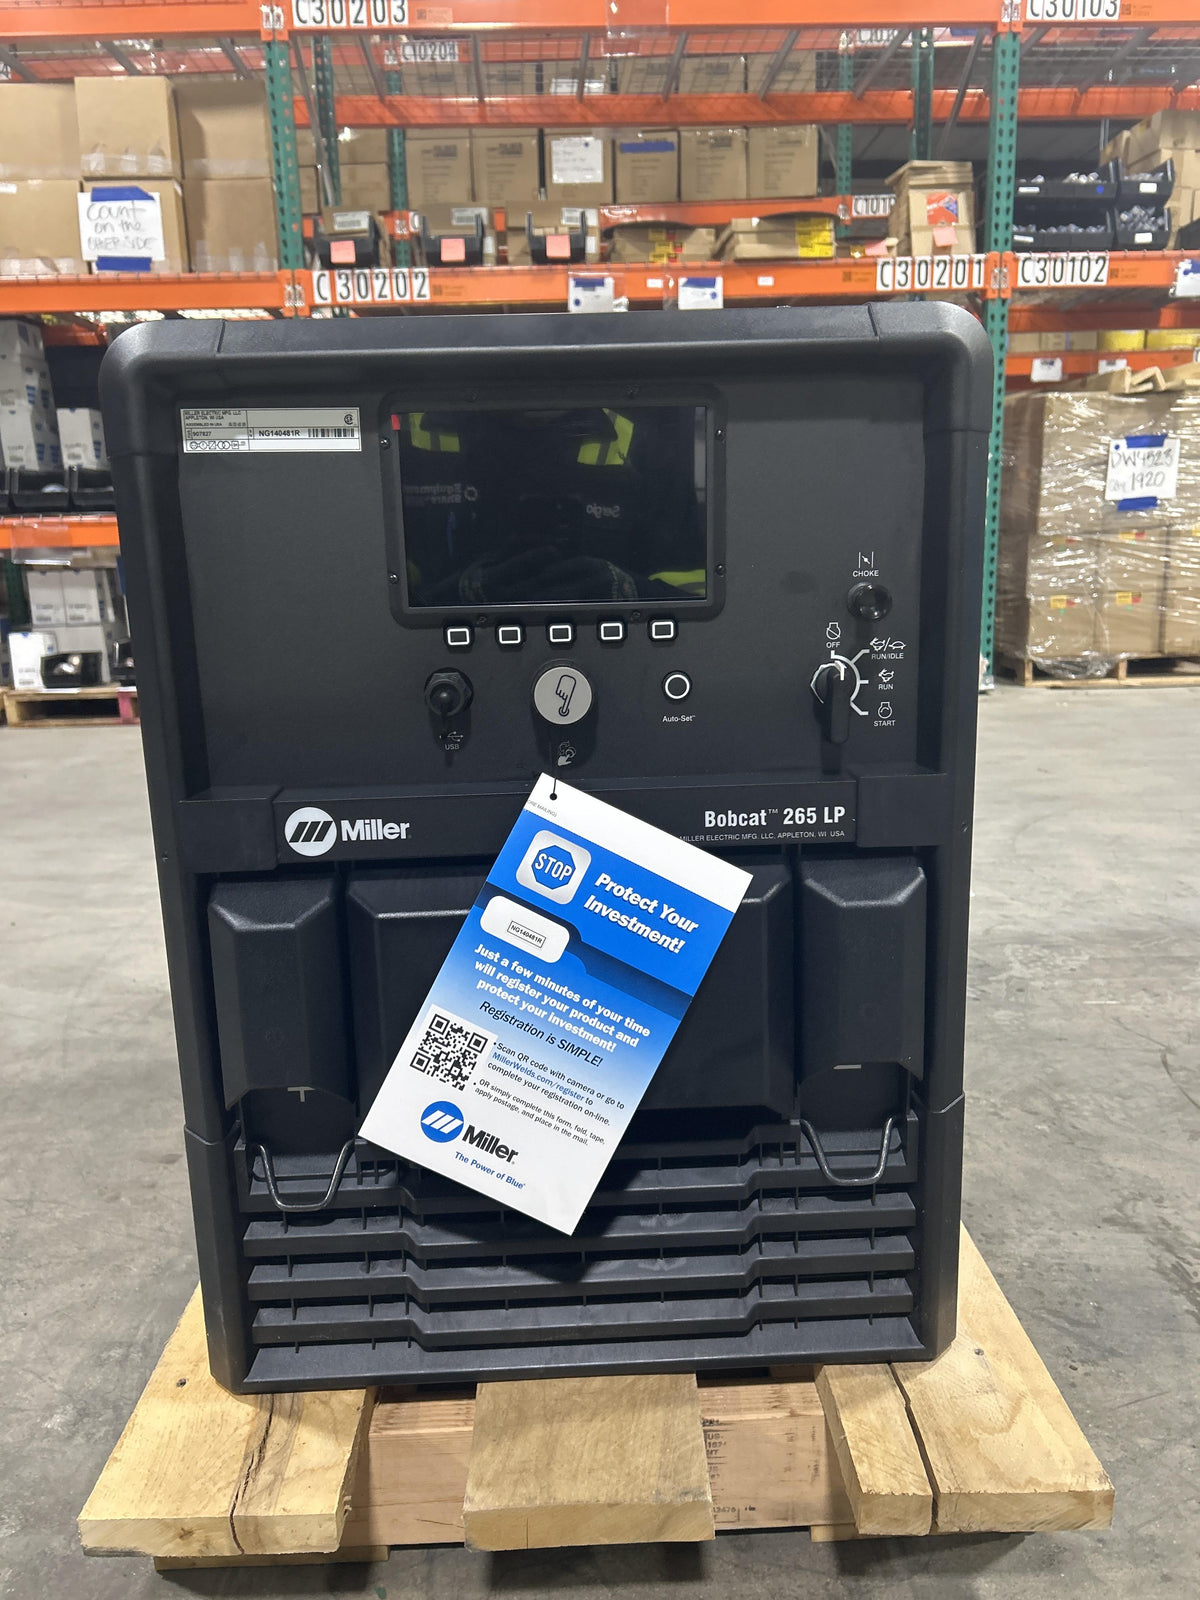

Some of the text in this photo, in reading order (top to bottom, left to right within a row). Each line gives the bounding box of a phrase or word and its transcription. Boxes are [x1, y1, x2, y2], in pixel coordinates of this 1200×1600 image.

[295, 0, 406, 24] C30203
[1029, 0, 1119, 17] C30103
[880, 256, 982, 288] C30201
[1021, 256, 1107, 283] C30102
[317, 270, 427, 301] C30202
[852, 569, 880, 577] CHOKE
[825, 641, 841, 649] OFF
[871, 652, 905, 660] RUN/IDLE
[340, 819, 410, 842] Miller
[782, 807, 818, 825] 265
[823, 806, 846, 824] LP
[706, 833, 740, 841] ELECTRIC
[534, 853, 573, 880] STOP
[594, 872, 699, 933] Protect Your
[510, 924, 543, 944] NG140481R
[583, 894, 686, 954] Investment!
[474, 943, 651, 1037] Just a few minutes of your time
[474, 960, 640, 1048] will register your product and
[476, 979, 617, 1053] protect your investment!
[479, 1000, 604, 1068] Registration is SIMPLE!
[487, 1062, 523, 1083] complete
[522, 1079, 541, 1092] your
[540, 1087, 584, 1113] registration
[492, 1051, 594, 1106] MillerWelds.com/register to
[496, 1042, 625, 1110] Scan QR code with camera or go to
[474, 1087, 494, 1101] apply
[520, 1109, 536, 1120] and
[533, 1115, 553, 1129] place
[553, 1124, 560, 1132] in
[560, 1127, 572, 1138] the
[479, 1078, 491, 1088] OR
[489, 1085, 512, 1100] simply
[512, 1095, 543, 1114] complete
[542, 1110, 555, 1120] this
[461, 1123, 519, 1164] Miller
[454, 1150, 469, 1164] The
[470, 1158, 495, 1176] Power
[495, 1172, 506, 1181] of
